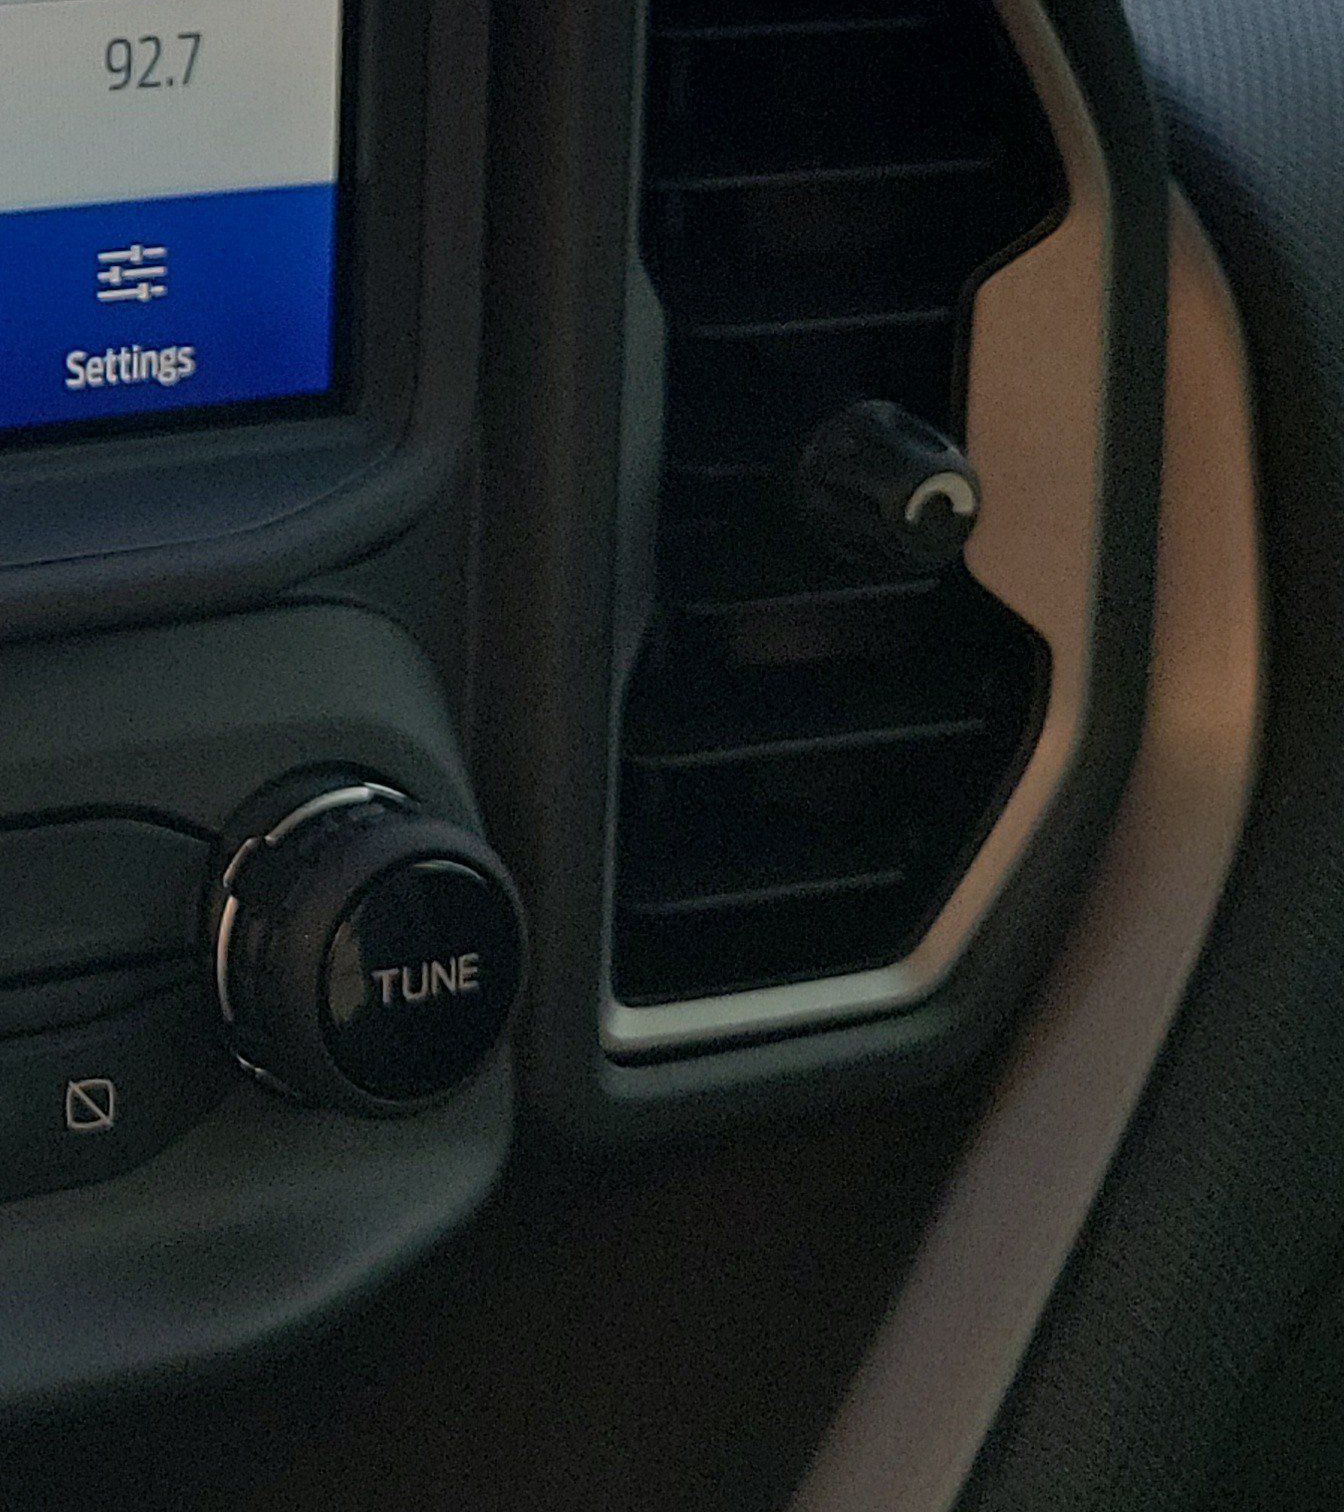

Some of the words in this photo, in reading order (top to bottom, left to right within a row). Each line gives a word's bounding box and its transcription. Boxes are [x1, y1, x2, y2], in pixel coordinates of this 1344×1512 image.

[104, 31, 203, 92] 92.7
[65, 344, 195, 389] Settings
[372, 952, 479, 1005] TUNE
